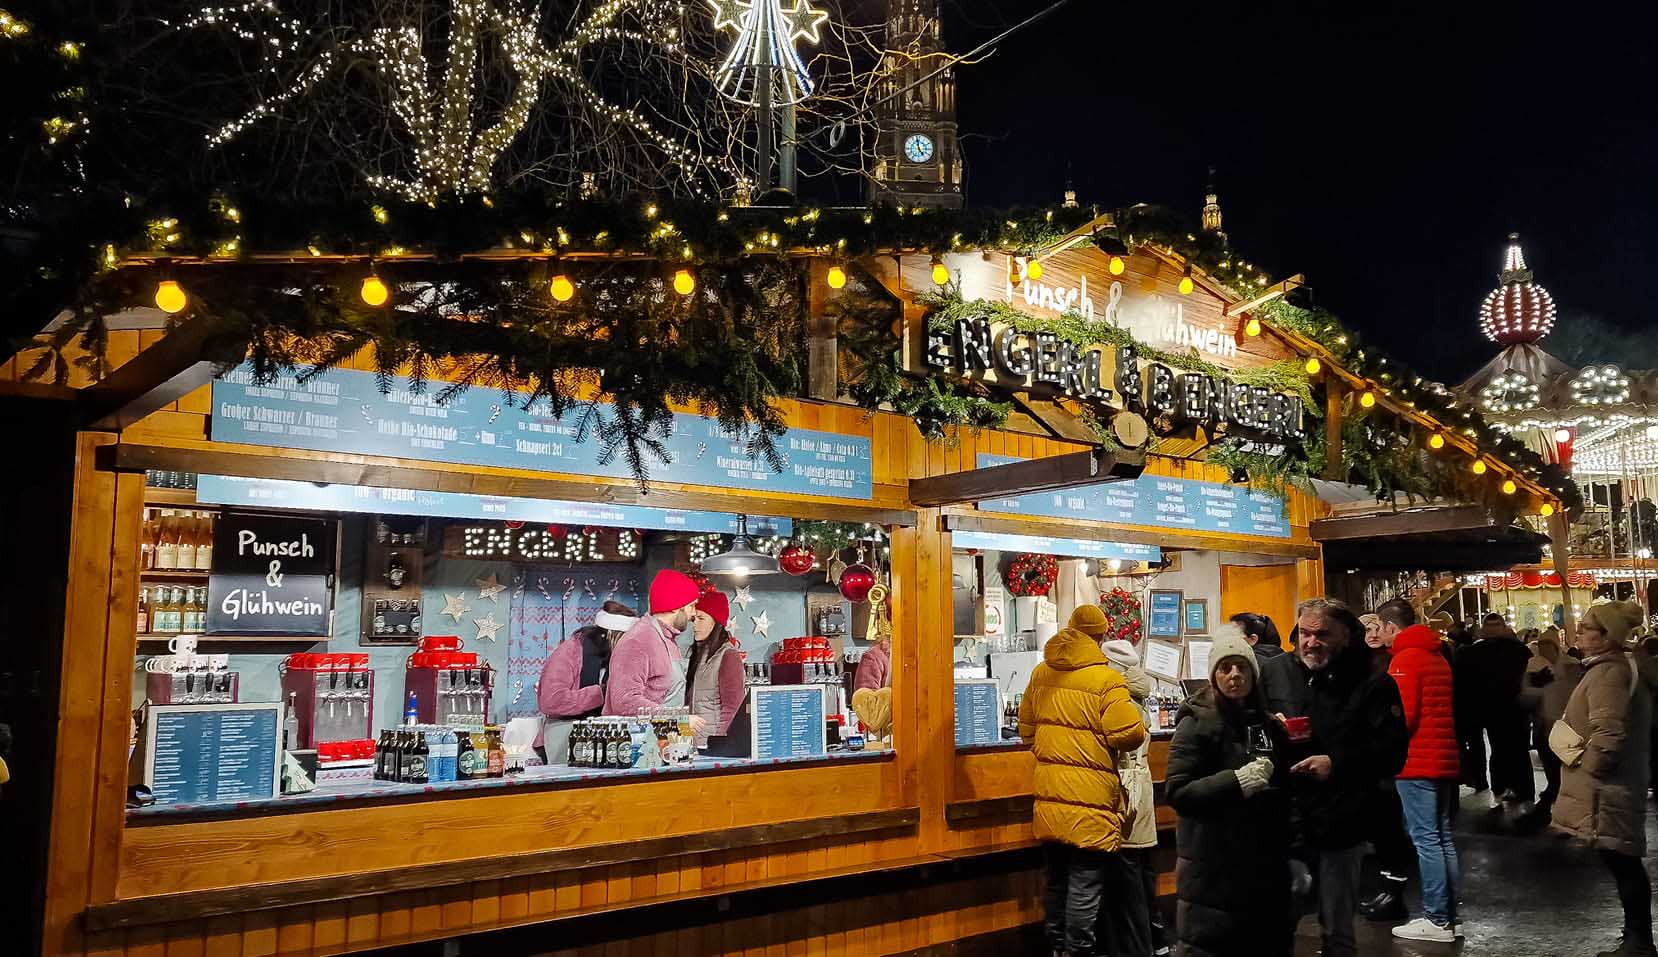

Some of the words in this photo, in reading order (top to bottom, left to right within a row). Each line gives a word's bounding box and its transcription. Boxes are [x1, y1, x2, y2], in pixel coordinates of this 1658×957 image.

[1006, 255, 1094, 323] Punsch
[1105, 281, 1123, 327] &
[922, 317, 1113, 402] ENGERL
[1147, 363, 1306, 438] BENGERL
[221, 402, 250, 421] Großer
[253, 406, 295, 425] Schwarzer
[306, 412, 338, 428] Brauner
[238, 529, 314, 558] Punsch
[266, 560, 284, 588] &
[221, 588, 322, 620] Glühwein
